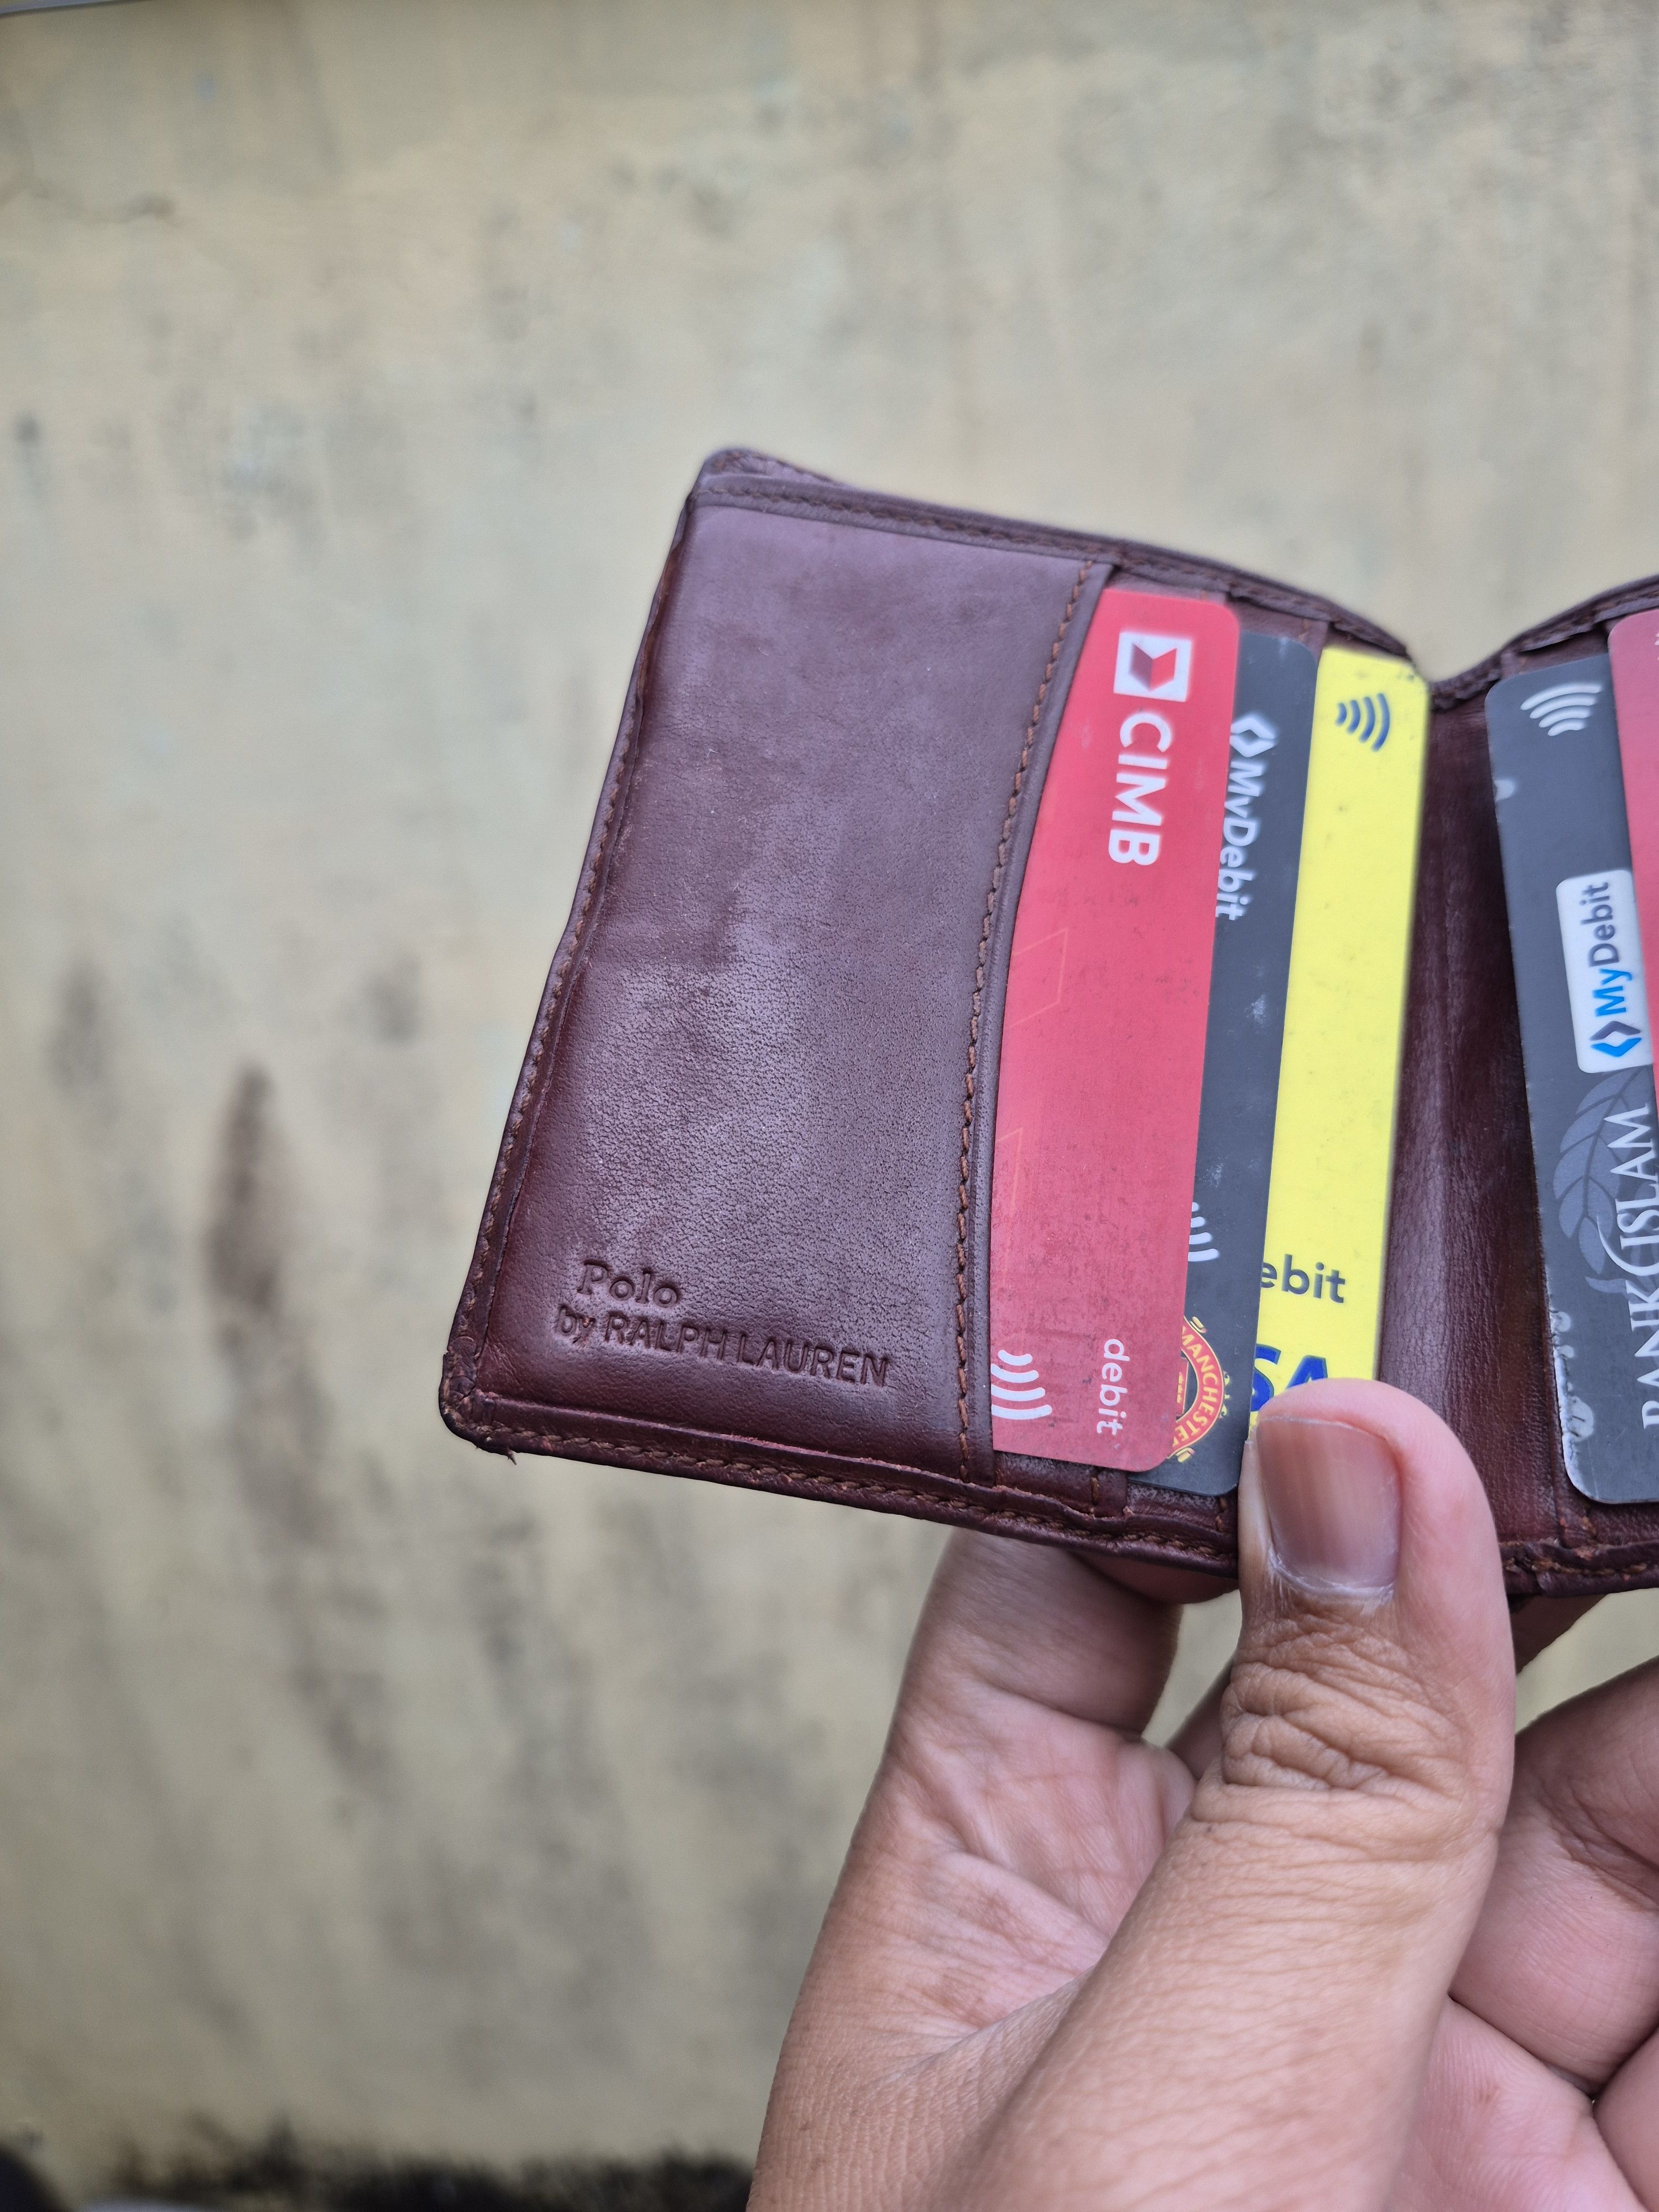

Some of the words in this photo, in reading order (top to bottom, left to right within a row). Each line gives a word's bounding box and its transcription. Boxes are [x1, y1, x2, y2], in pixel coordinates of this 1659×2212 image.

[1108, 712, 1173, 866] CIMB
[1215, 759, 1263, 921] MyDebit
[1579, 881, 1632, 1016] MyDebit
[1604, 1103, 1659, 1250] ISLAM
[556, 1305, 595, 1344] by
[604, 1310, 727, 1360] RALPH
[736, 1331, 890, 1385] LAUREN
[577, 1259, 680, 1307] Polo
[1097, 1339, 1130, 1436] debit
